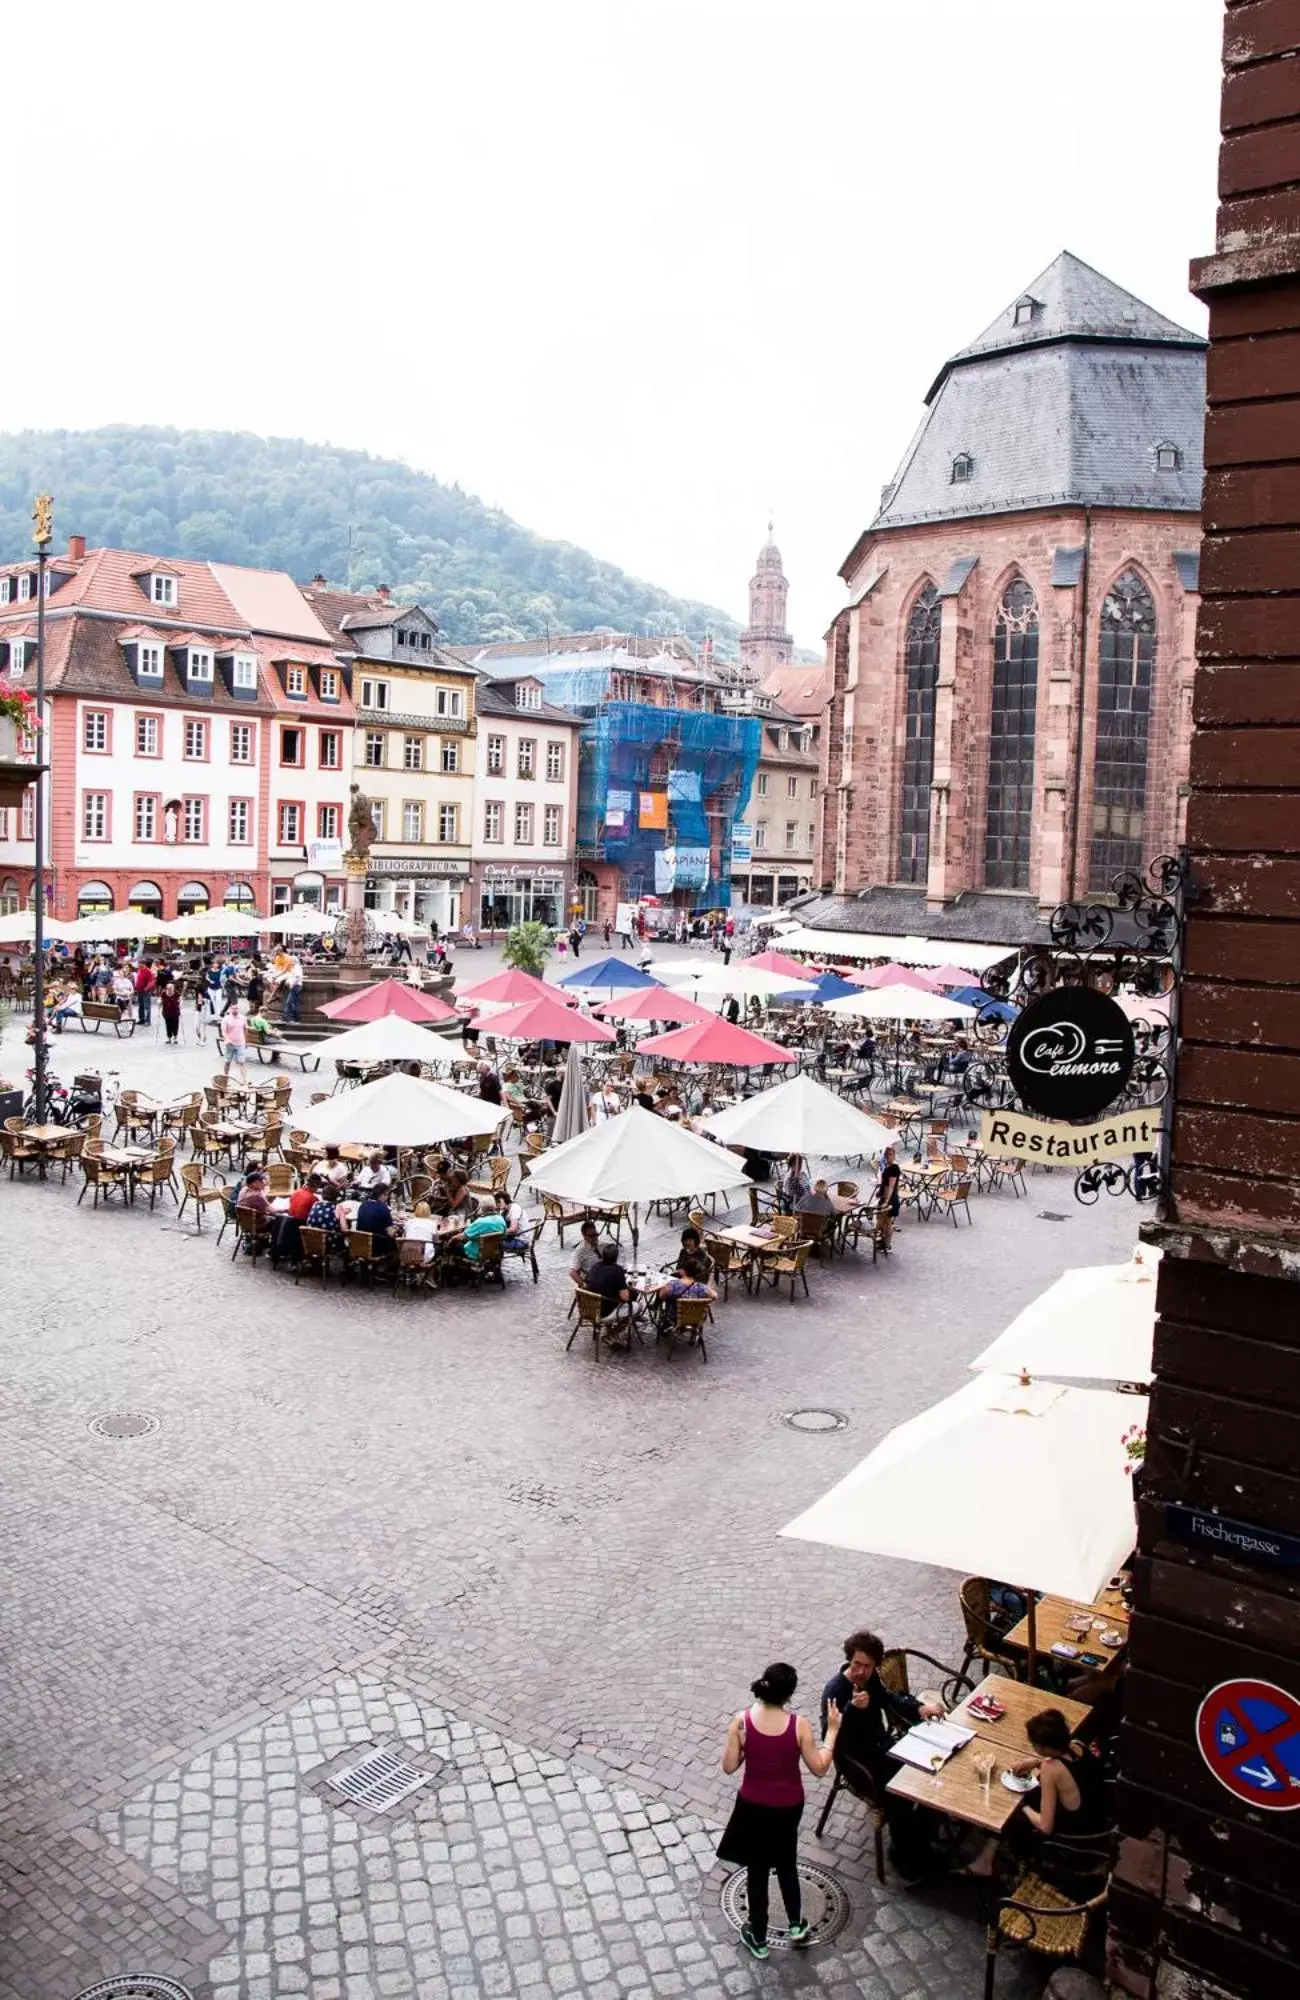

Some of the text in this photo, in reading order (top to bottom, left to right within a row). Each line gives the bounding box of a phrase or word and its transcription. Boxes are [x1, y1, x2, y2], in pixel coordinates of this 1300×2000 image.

[1034, 1043, 1065, 1059] Café
[989, 1121, 1149, 1157] Restaurant
[1192, 1516, 1280, 1555] Fischergasse
